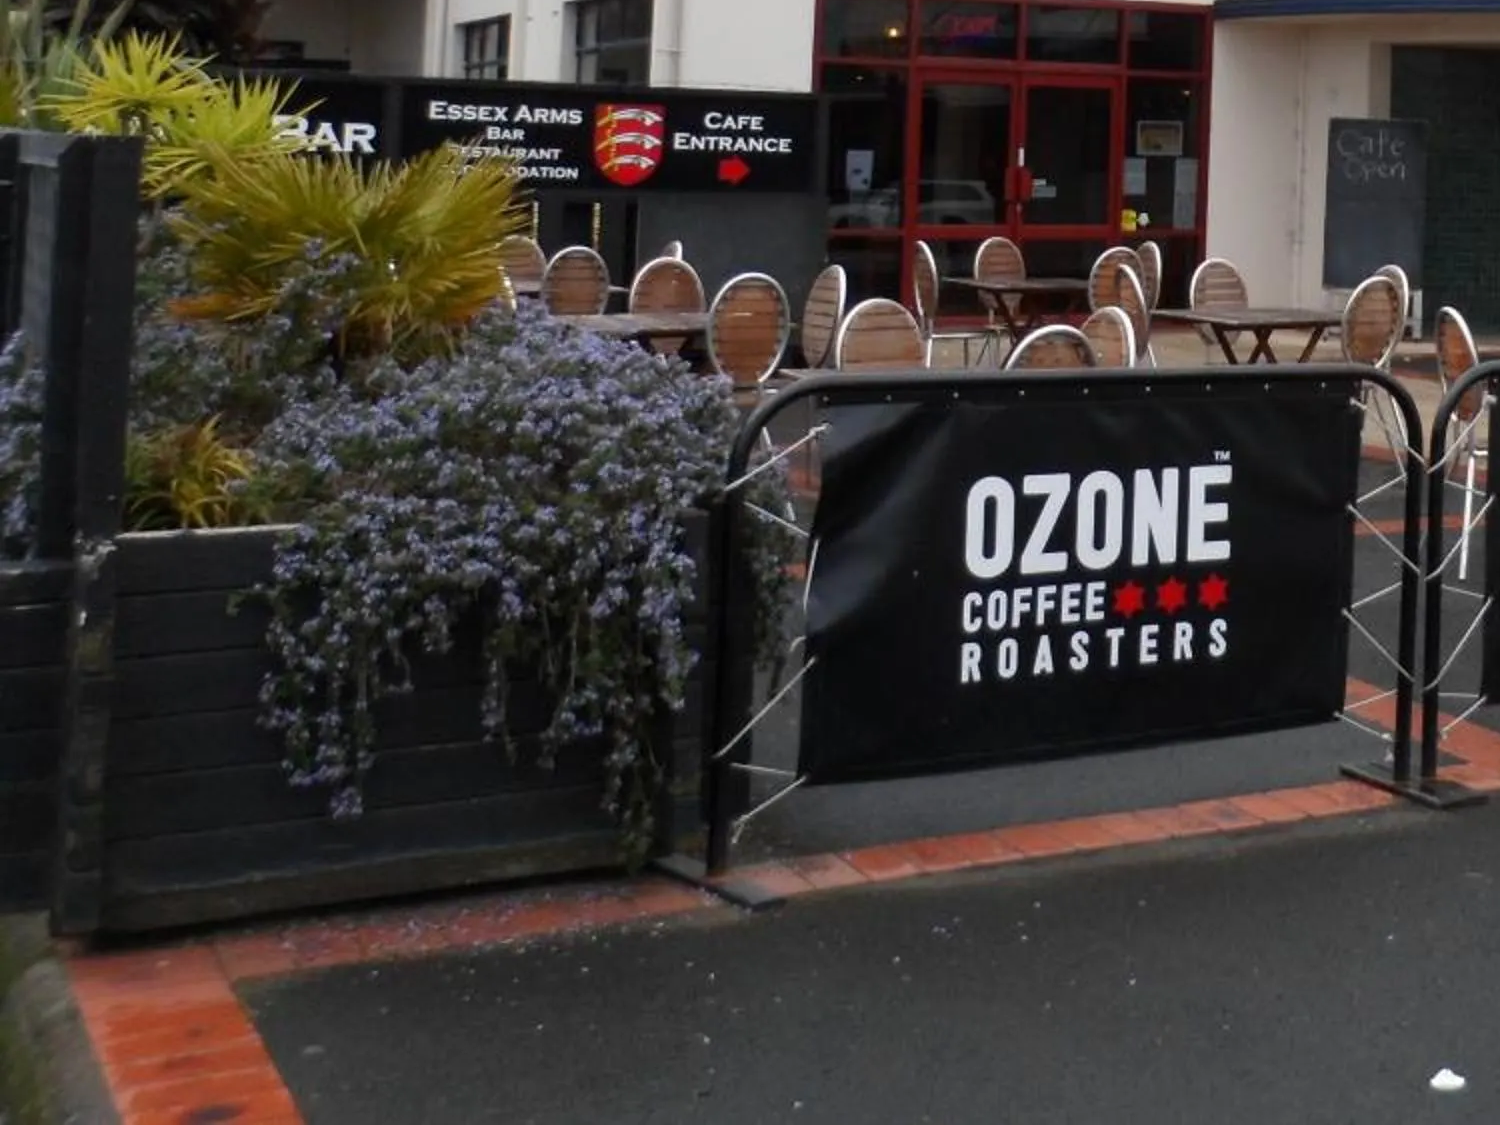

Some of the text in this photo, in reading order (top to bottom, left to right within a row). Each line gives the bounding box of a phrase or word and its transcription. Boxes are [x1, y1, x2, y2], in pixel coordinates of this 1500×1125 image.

[428, 99, 584, 125] ESSEX ARMS
[703, 111, 765, 131] CAFE
[486, 125, 526, 141] BAR
[672, 131, 793, 153] ENTRANCE
[964, 463, 1234, 579] OZONE
[962, 579, 1108, 634] COFFEE
[959, 617, 1229, 685] ROASTERS
